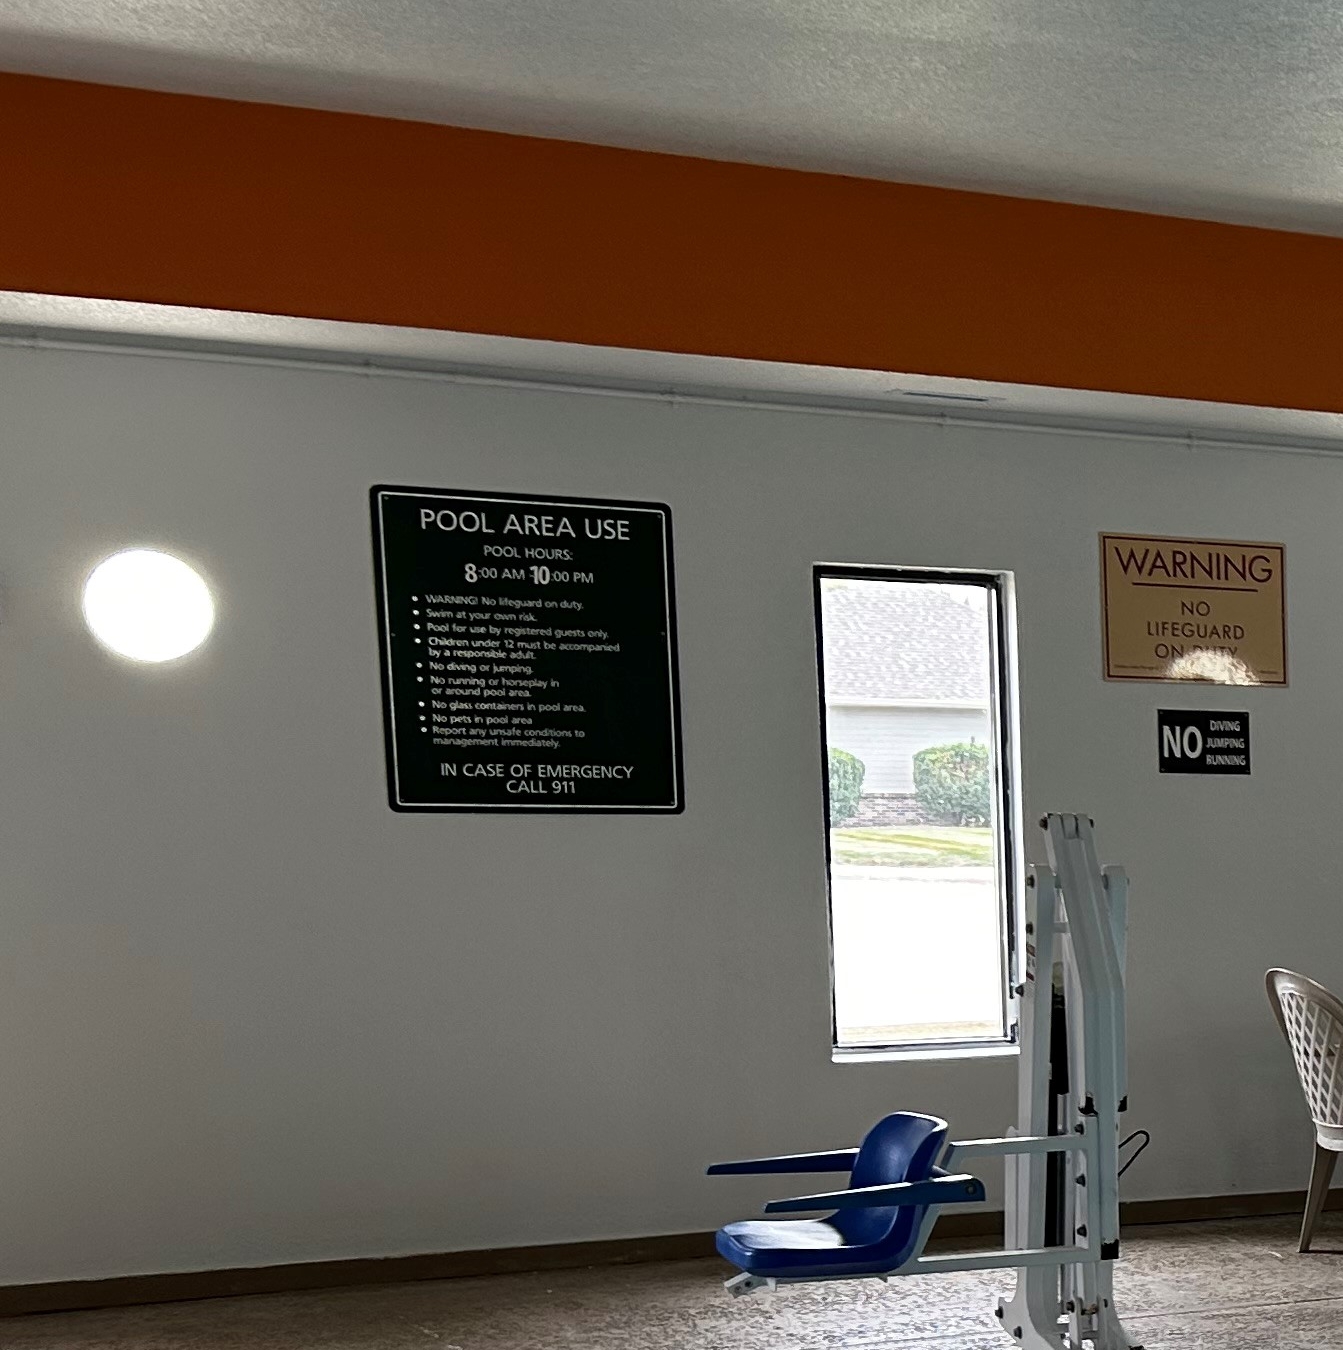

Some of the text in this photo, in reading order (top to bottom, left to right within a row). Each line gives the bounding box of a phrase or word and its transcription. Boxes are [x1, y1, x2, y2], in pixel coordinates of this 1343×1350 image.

[420, 508, 630, 541] POOL AREA USE
[483, 545, 573, 561] POOL HOURS:
[1114, 546, 1273, 583] WARNING
[464, 563, 498, 583] 8:00
[501, 569, 526, 581] AM
[573, 572, 594, 584] PM
[481, 596, 496, 606] No
[498, 597, 542, 609] lifeguard
[560, 599, 584, 611] duty.
[1181, 600, 1211, 617] NO
[426, 608, 453, 618] Swim
[455, 611, 467, 619] at
[469, 612, 491, 621] your
[426, 622, 449, 632] Pool
[452, 623, 467, 632] for
[488, 625, 501, 636] by
[504, 626, 552, 637] registered
[554, 629, 585, 638] guests
[587, 629, 609, 640] only.
[1147, 621, 1245, 640] LIFEGUARD
[428, 637, 620, 652] Children under 12 must be accompanied
[1155, 643, 1185, 659] ON
[427, 646, 441, 658] by
[453, 649, 507, 658] responsible
[429, 661, 444, 670] No
[447, 662, 477, 673] diving
[430, 675, 445, 684] No
[448, 676, 486, 687] running
[501, 677, 548, 689] horseplay
[550, 678, 559, 687] in
[445, 687, 480, 695] around
[483, 688, 505, 697] pool
[432, 700, 447, 708] No
[449, 700, 473, 711] glass
[475, 702, 524, 711] containers
[527, 702, 536, 711] in
[539, 703, 560, 712] pool
[432, 714, 447, 722] No
[450, 715, 472, 724] pets
[474, 714, 483, 723] in
[486, 715, 508, 725] pool
[1209, 720, 1240, 731] DIVING
[432, 726, 585, 738] Report any unsafe conditions to
[433, 738, 499, 747] management
[1162, 725, 1203, 759] NO
[1206, 737, 1245, 749] JUMPING
[1206, 754, 1246, 766] RUNNING
[440, 762, 634, 779] IN CASE OF EMERGENCY
[506, 780, 576, 794] CALL 911
